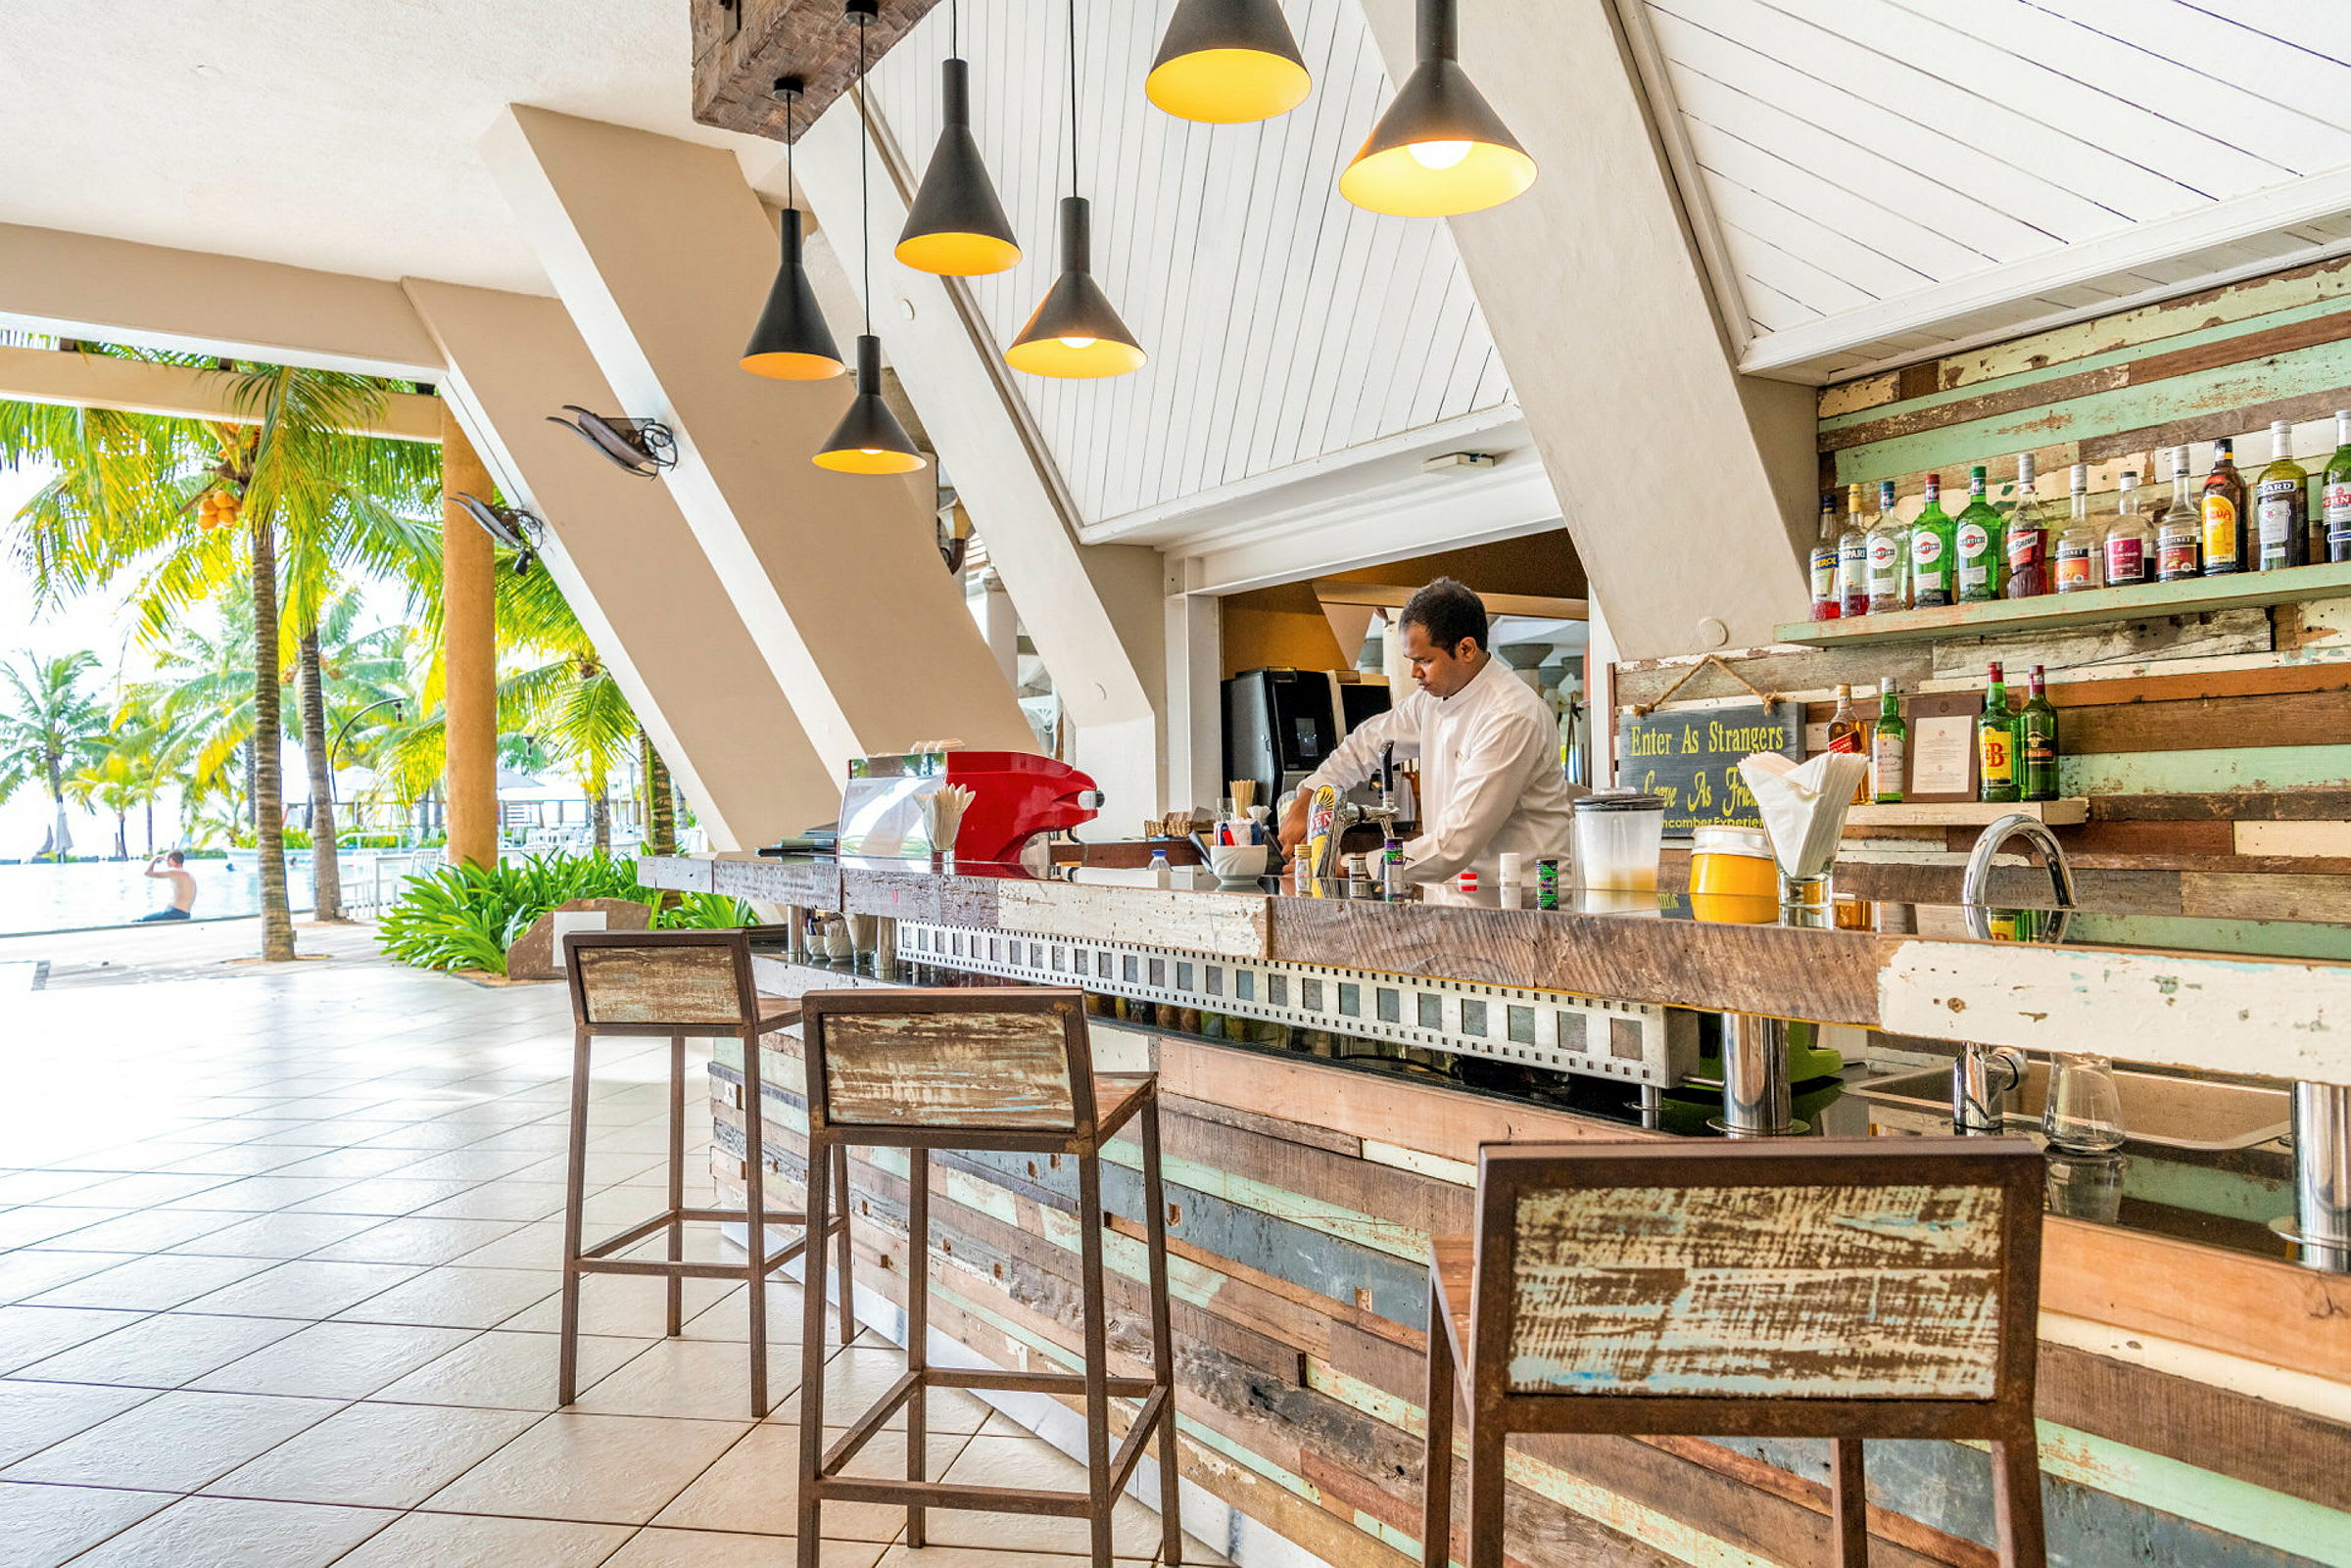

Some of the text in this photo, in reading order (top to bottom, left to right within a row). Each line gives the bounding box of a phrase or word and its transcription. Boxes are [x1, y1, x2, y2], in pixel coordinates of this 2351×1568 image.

[1630, 721, 1784, 756] Enter As Strangers
[1687, 771, 1711, 812] As
[1722, 766, 1758, 817] Frien
